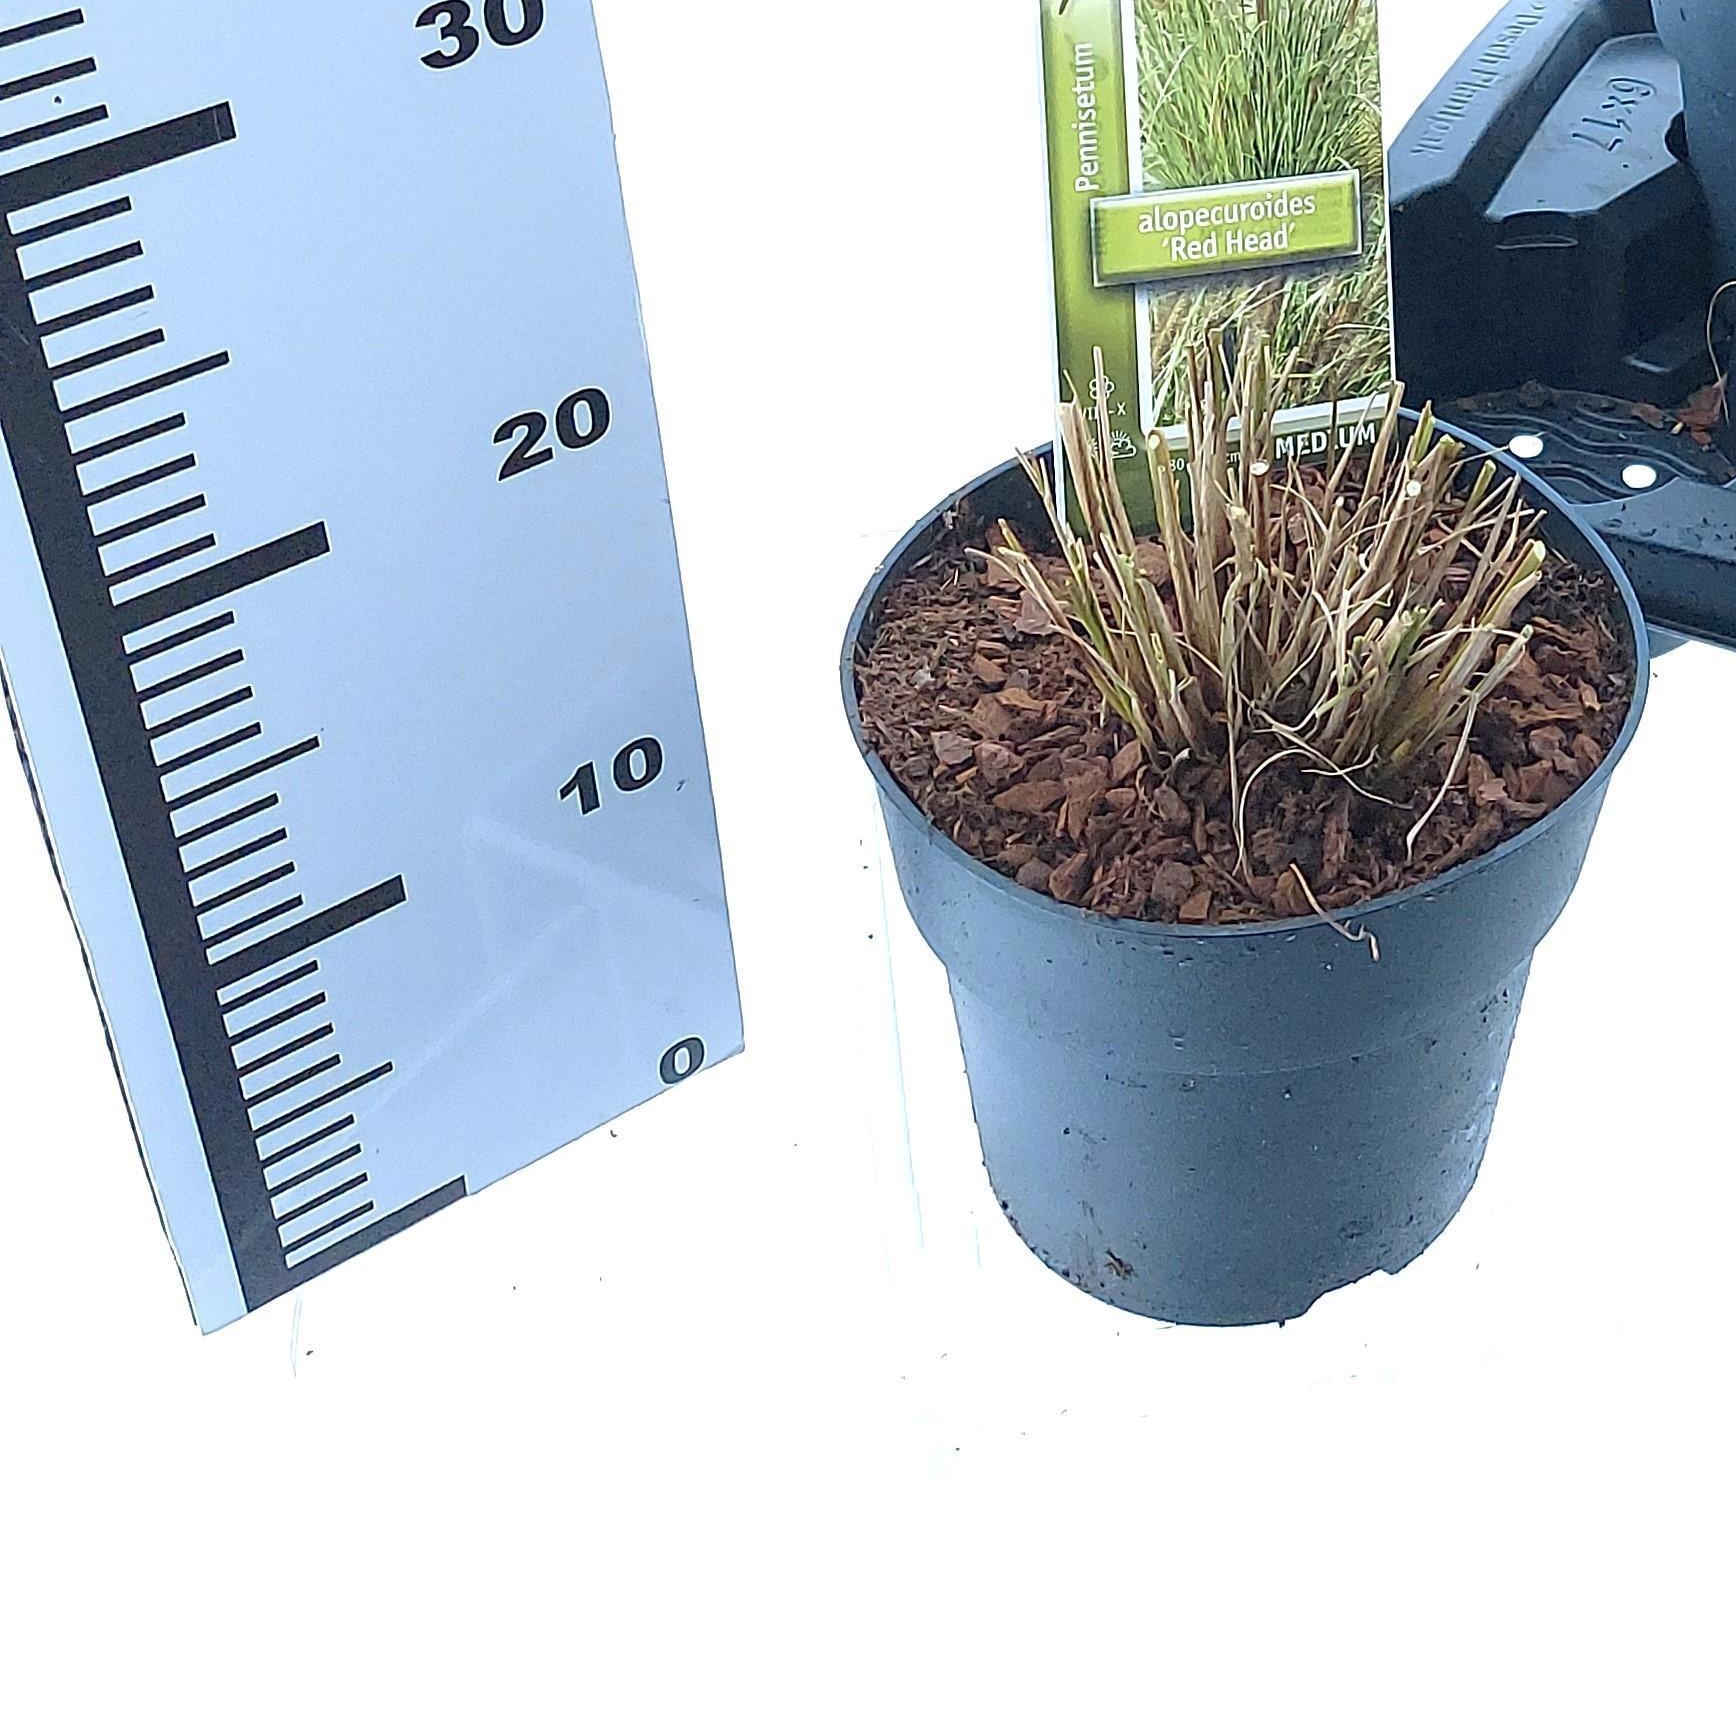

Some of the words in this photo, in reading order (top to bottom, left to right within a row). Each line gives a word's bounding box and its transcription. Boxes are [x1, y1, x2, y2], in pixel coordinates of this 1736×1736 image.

[1071, 41, 1100, 192] Pennisetum
[1138, 190, 1317, 236] alopecuroides
[494, 388, 609, 481] 20
[1275, 422, 1376, 460] MEDUM
[560, 738, 662, 815] 10
[660, 1037, 704, 1084] 0
